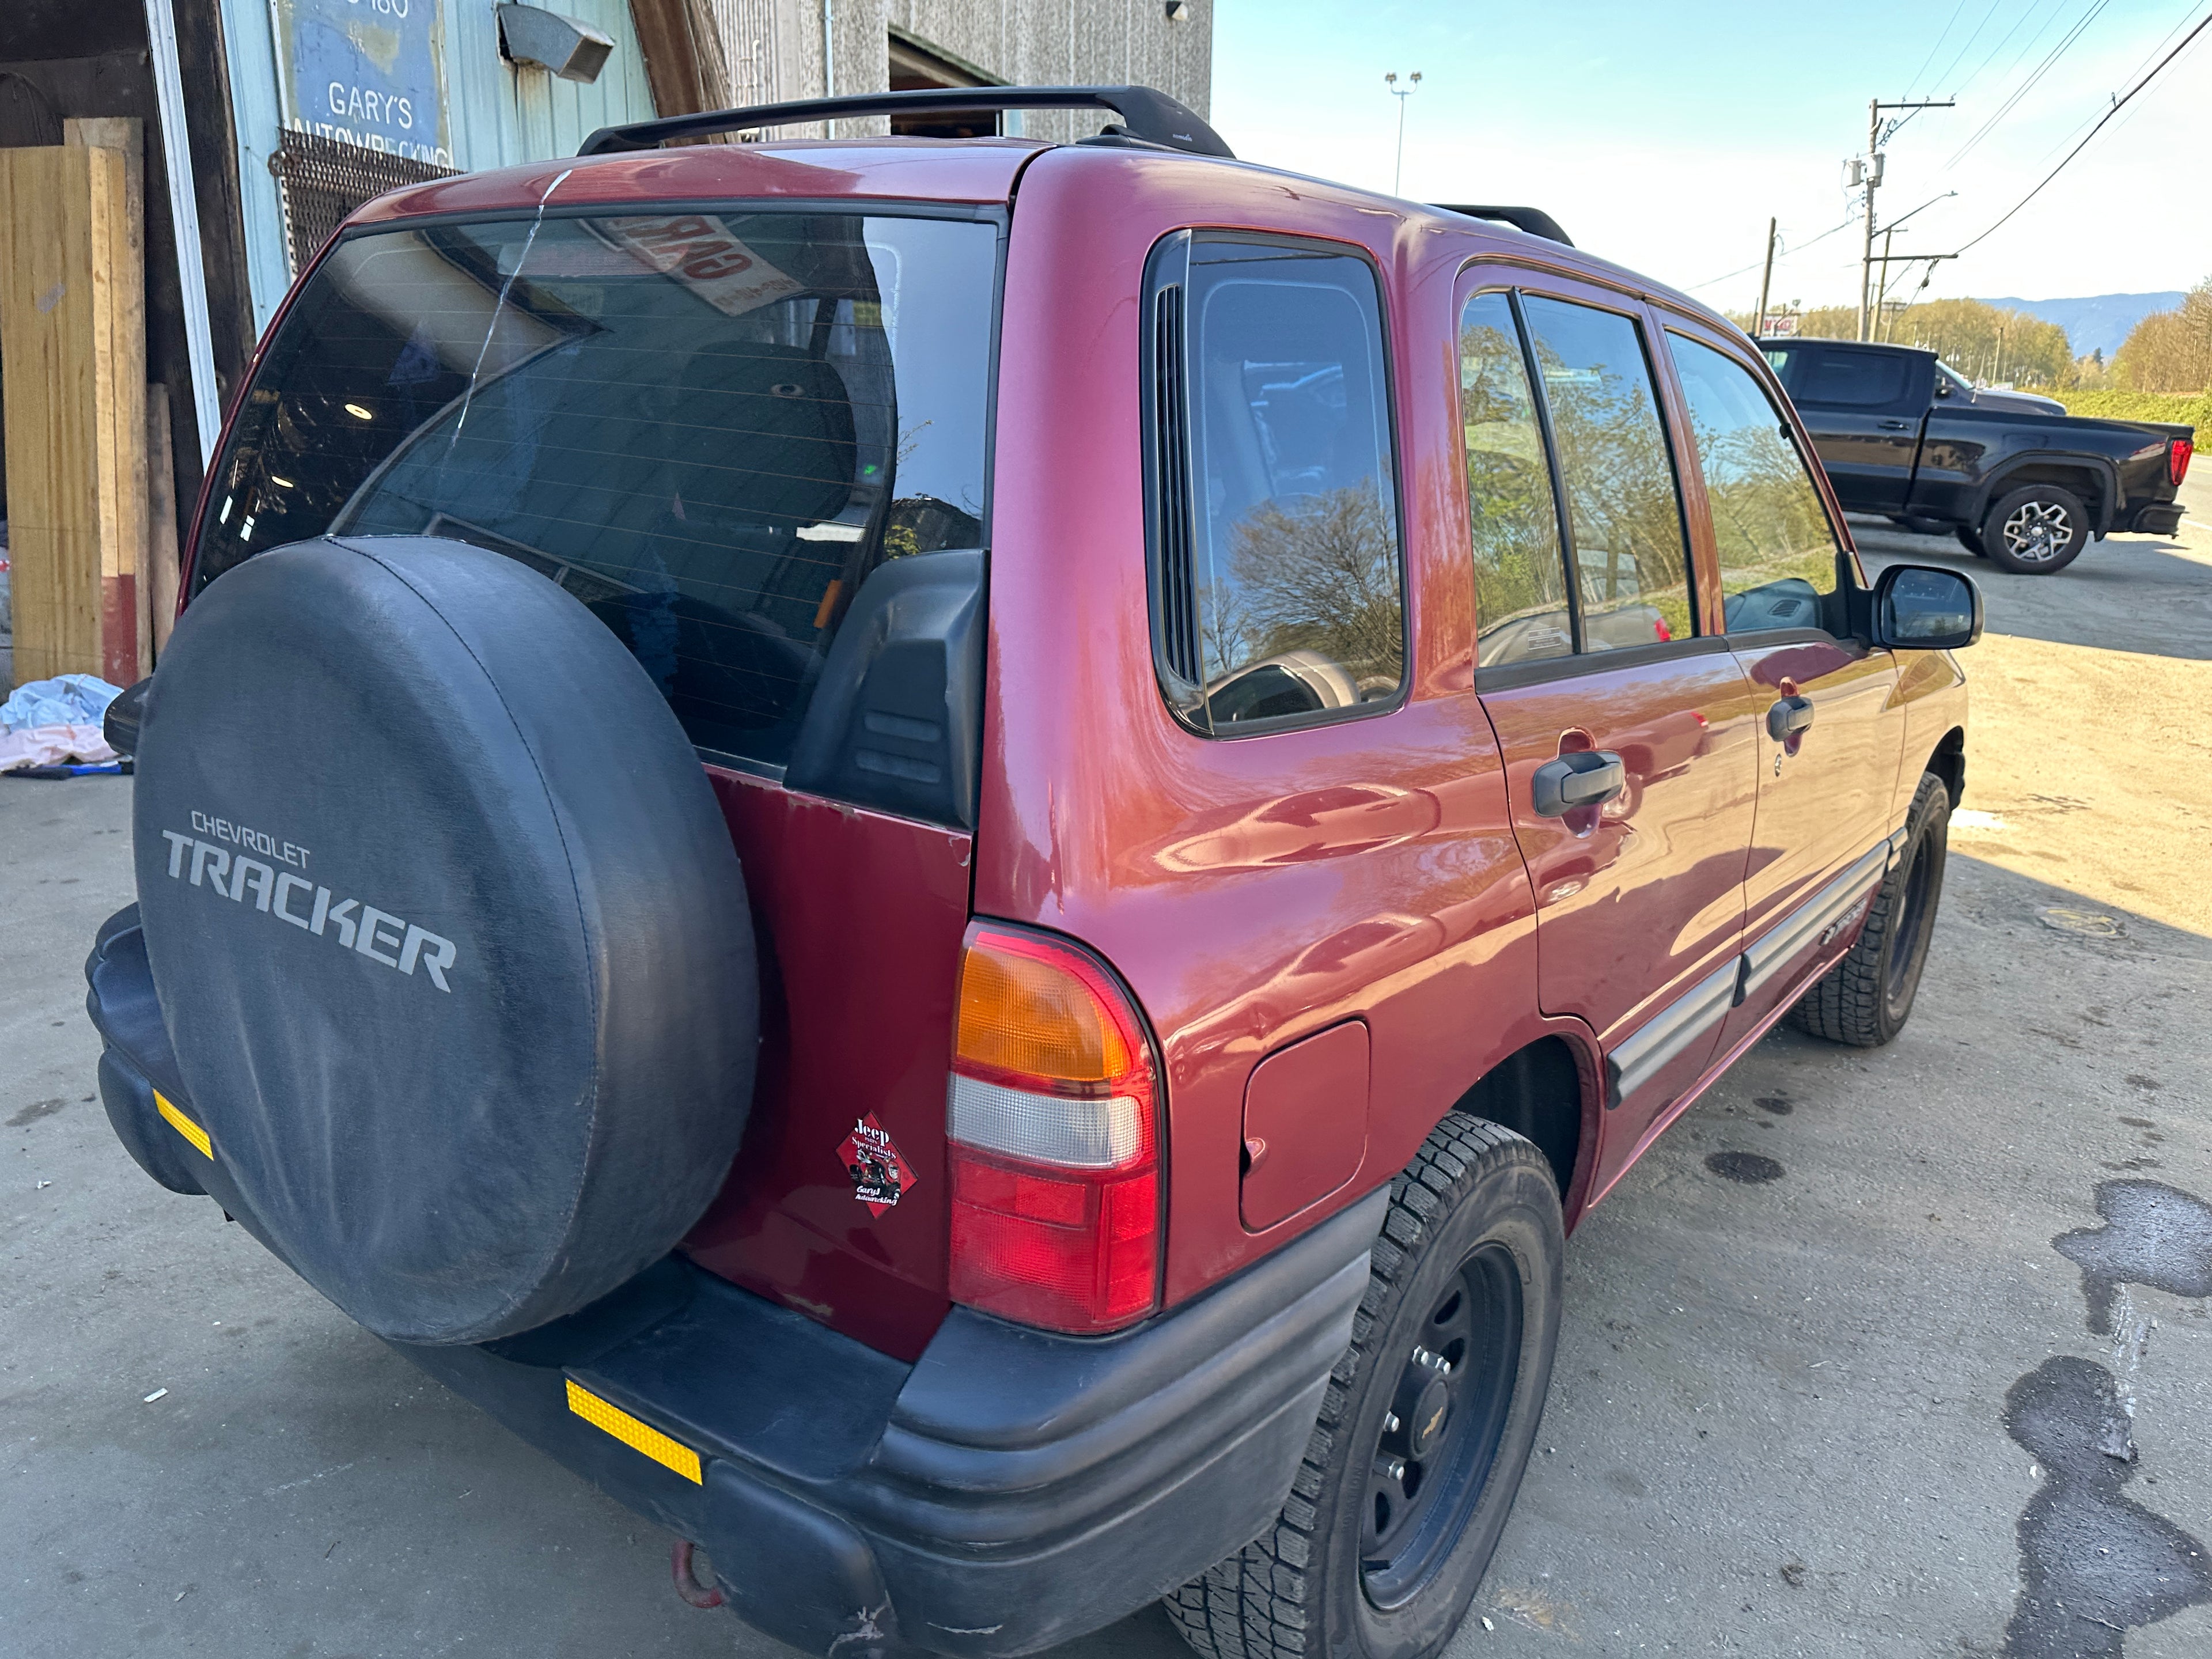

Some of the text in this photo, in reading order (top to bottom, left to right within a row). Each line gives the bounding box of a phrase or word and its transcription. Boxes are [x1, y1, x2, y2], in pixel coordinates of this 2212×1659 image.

[328, 82, 413, 130] GARY'S
[191, 810, 310, 869] CHEVROLET
[162, 830, 457, 994] TRACKER
[851, 1136, 897, 1160] Specialists
[854, 1119, 890, 1147] Jeep
